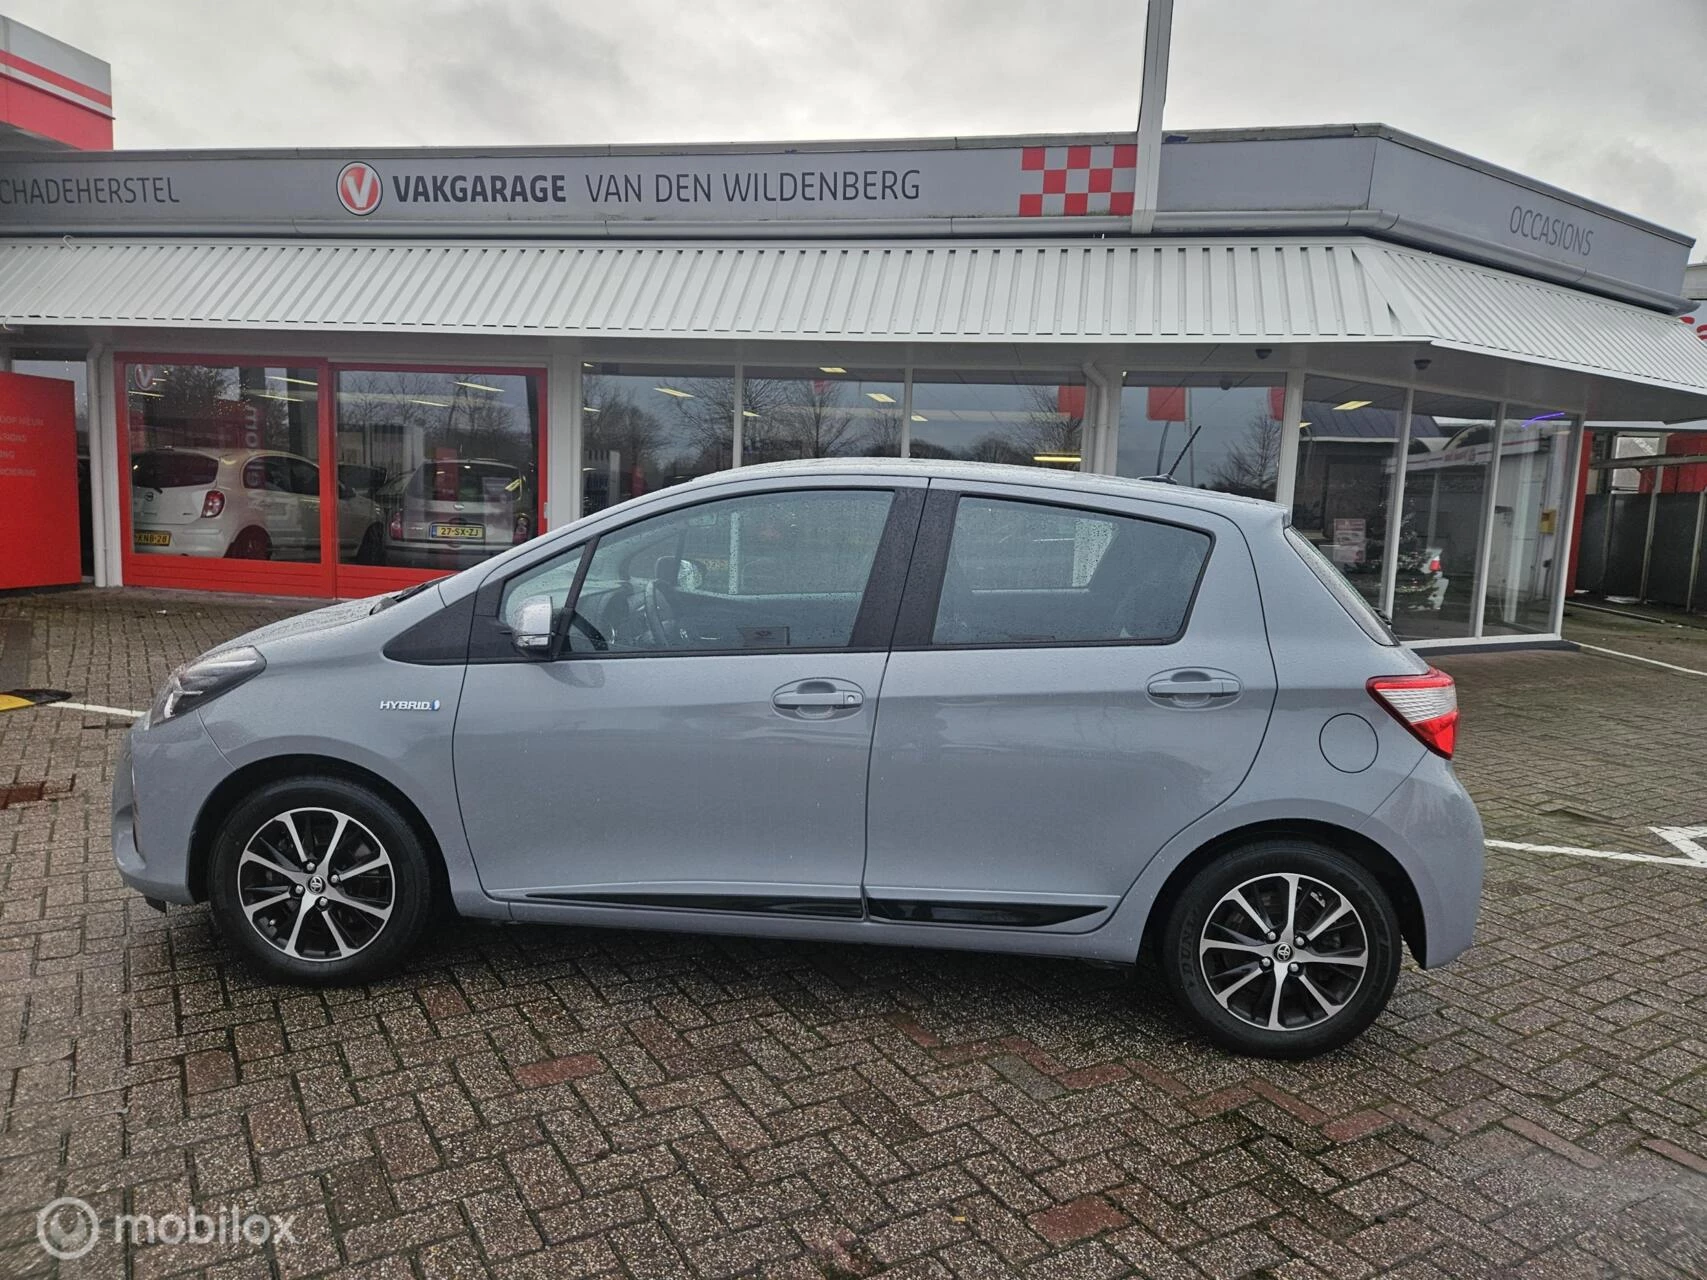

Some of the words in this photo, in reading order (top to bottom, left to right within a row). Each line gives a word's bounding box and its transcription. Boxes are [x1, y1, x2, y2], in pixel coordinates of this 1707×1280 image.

[0, 177, 180, 205] CHADEHERSTEL
[392, 174, 567, 203] VAKGARAGE
[585, 173, 642, 203] VAN
[655, 173, 712, 203] DEN
[722, 169, 921, 202] WILDENBERG
[1509, 206, 1594, 256] OCCASIONS
[380, 700, 431, 710] HYBRID
